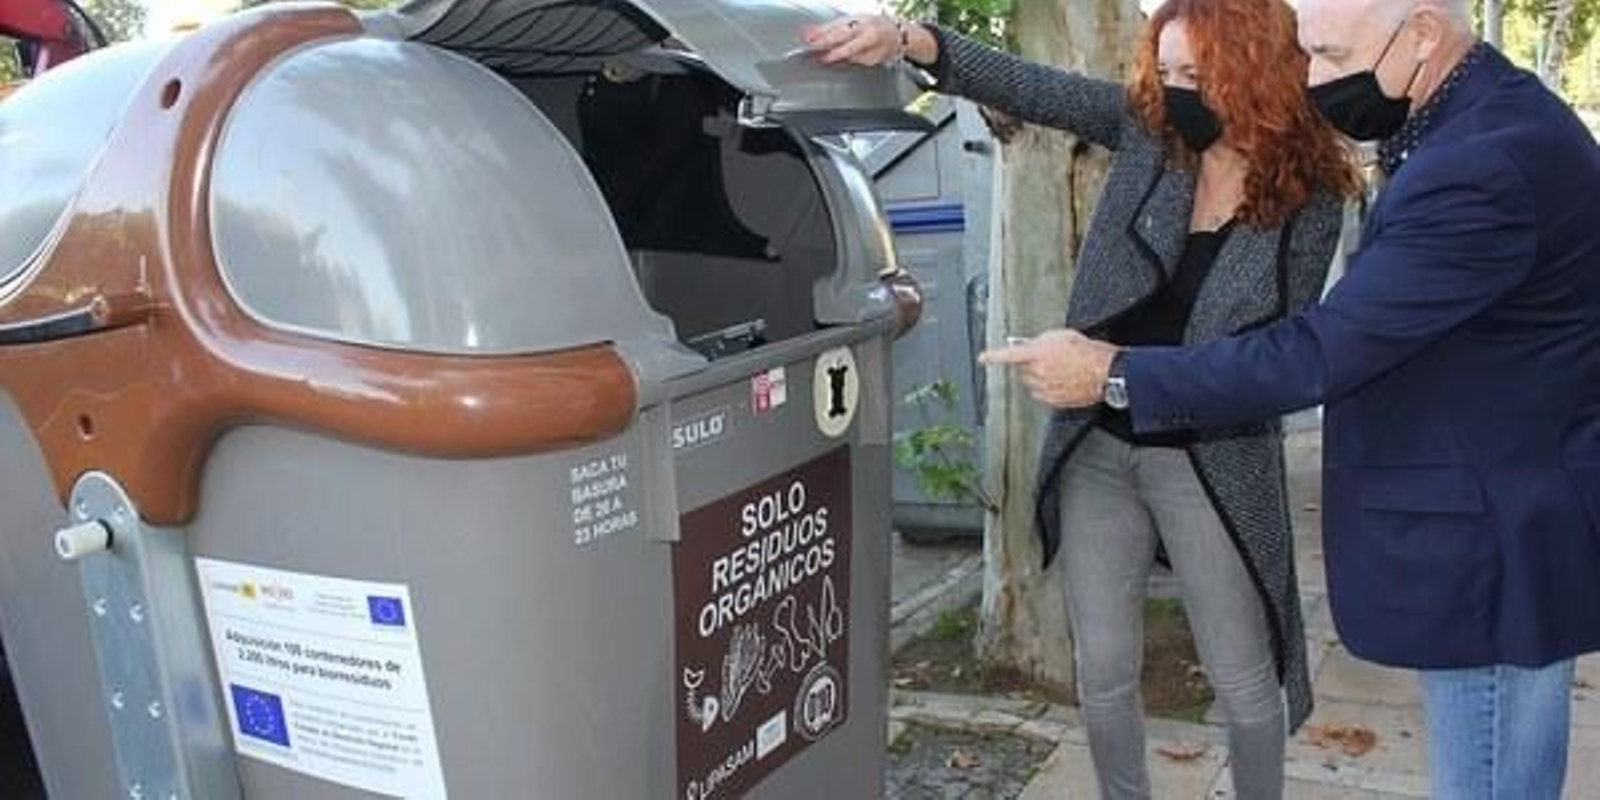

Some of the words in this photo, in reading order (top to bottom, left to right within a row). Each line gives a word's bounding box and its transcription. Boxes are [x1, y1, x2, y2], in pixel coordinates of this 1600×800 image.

[673, 412, 725, 448] SULO
[571, 460, 610, 484] SACA
[610, 453, 627, 470] TU
[572, 474, 627, 505] BASURA
[574, 505, 592, 523] DE
[612, 496, 622, 512] A
[742, 481, 805, 536] SOLO
[574, 527, 591, 545] 23
[593, 510, 638, 540] HORAS
[711, 507, 828, 594] RESIDUOS
[292, 663, 315, 678] para
[305, 646, 382, 672] contenedores
[385, 660, 401, 675] de
[699, 739, 754, 800] LIPASAM
